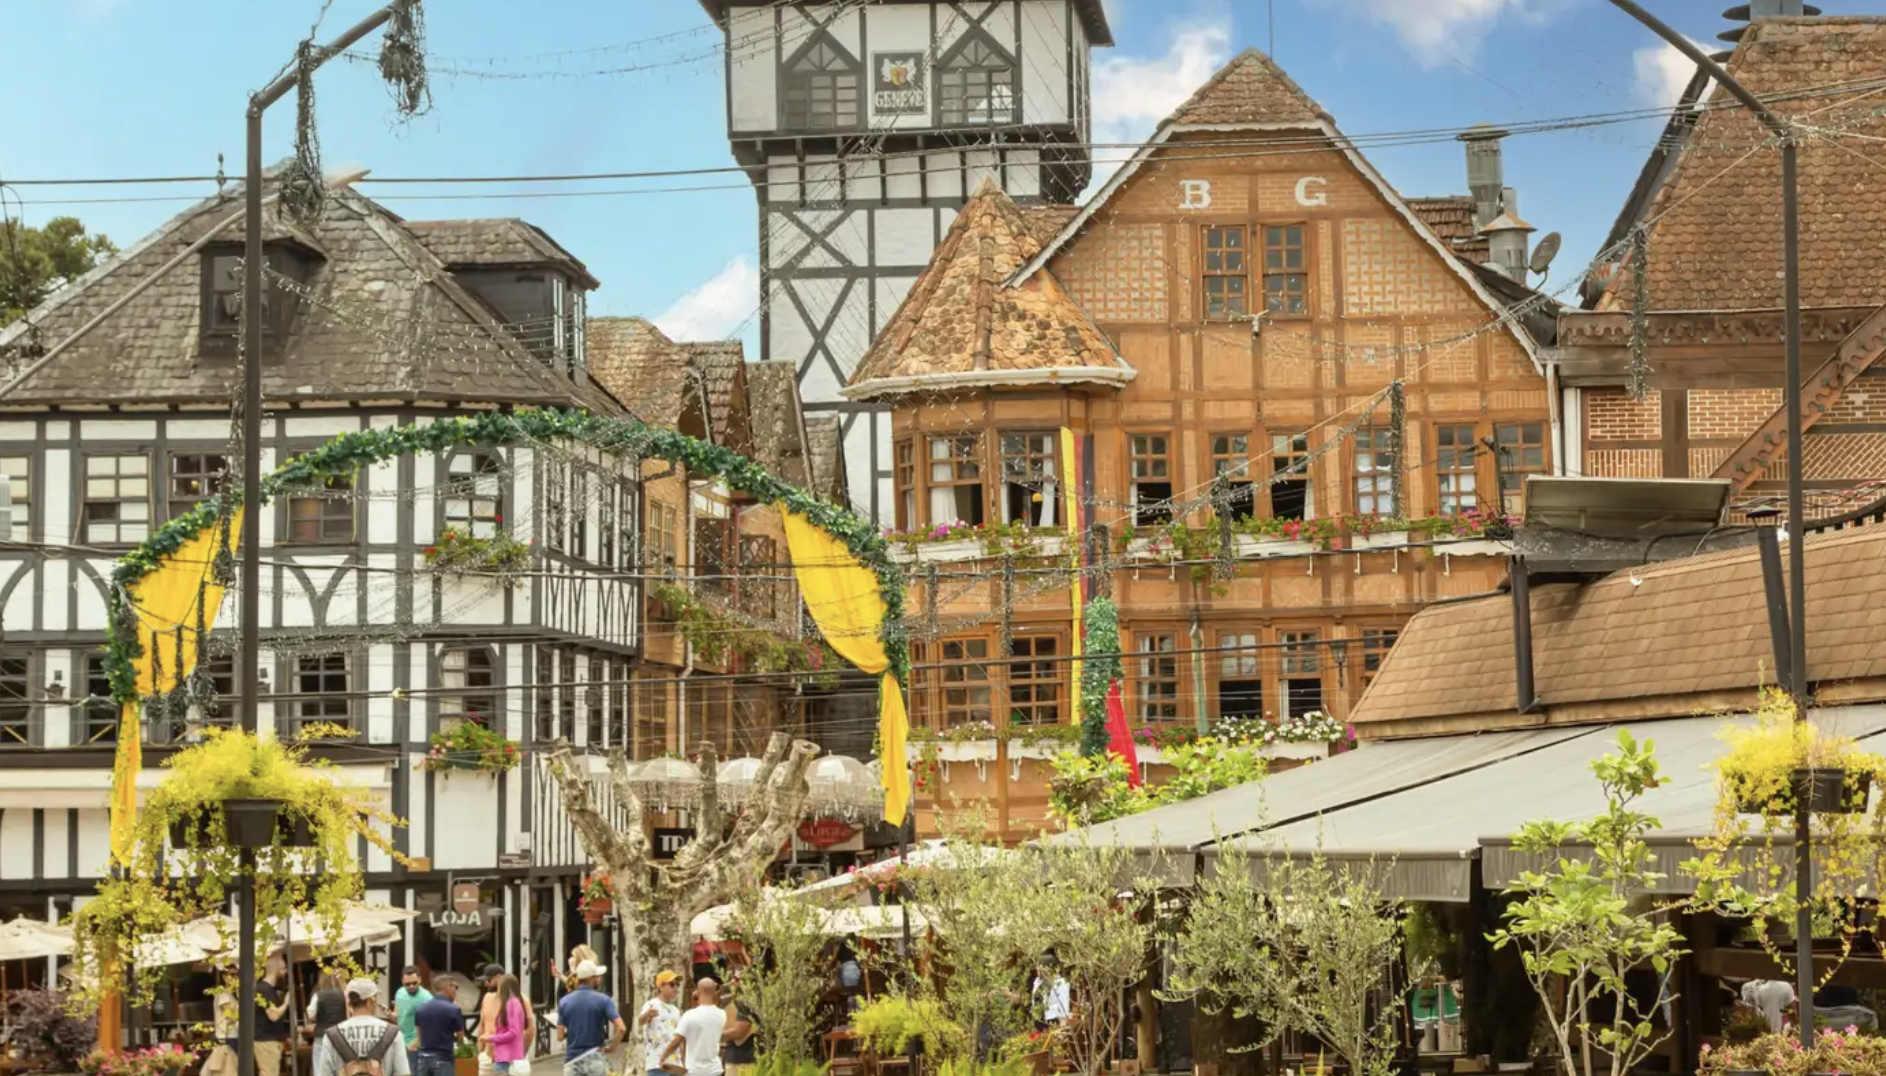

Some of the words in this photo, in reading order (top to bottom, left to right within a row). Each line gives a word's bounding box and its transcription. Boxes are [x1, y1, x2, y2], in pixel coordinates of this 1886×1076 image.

[1179, 179, 1211, 209] B
[1295, 176, 1327, 206] G
[429, 910, 481, 928] LOJA
